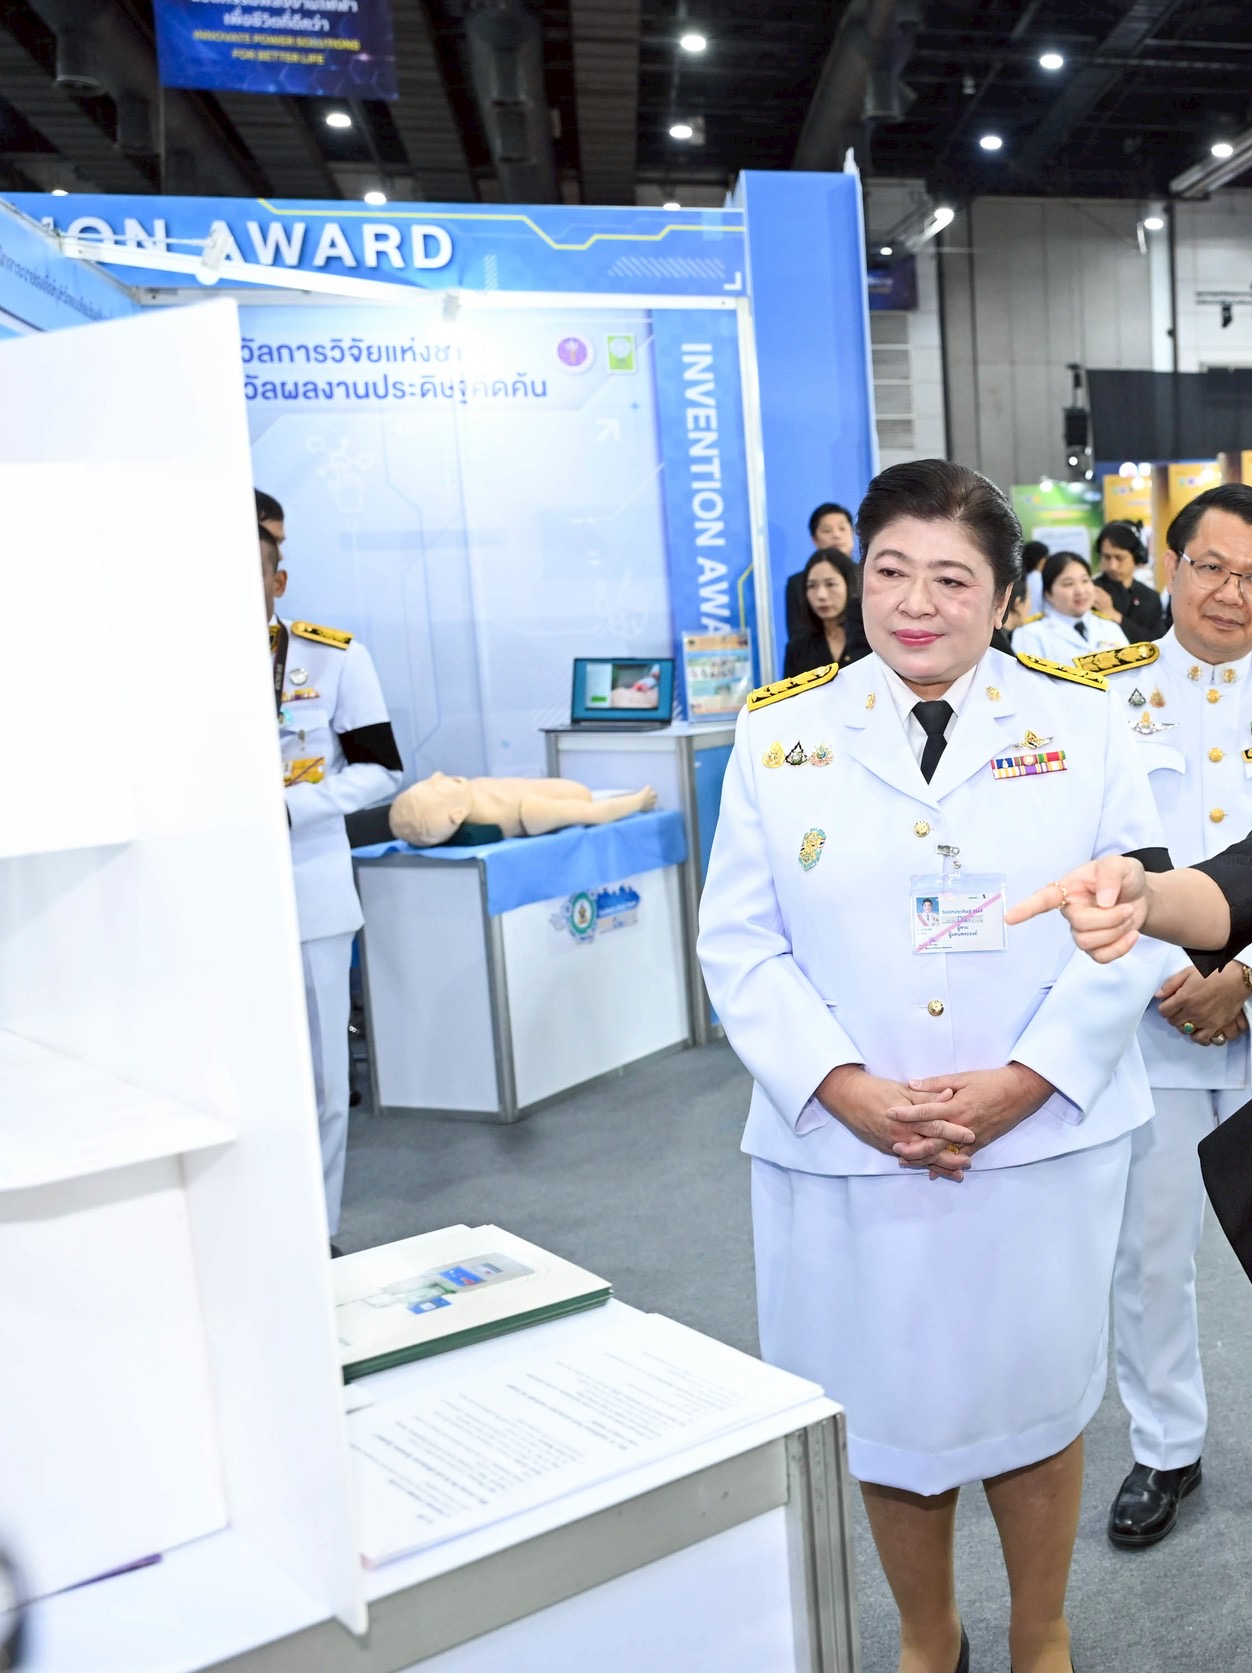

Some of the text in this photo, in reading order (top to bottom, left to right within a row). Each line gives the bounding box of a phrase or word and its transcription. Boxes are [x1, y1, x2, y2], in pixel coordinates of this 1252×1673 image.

[42, 216, 454, 271] ON AWARD
[681, 343, 726, 547] INVENTION
